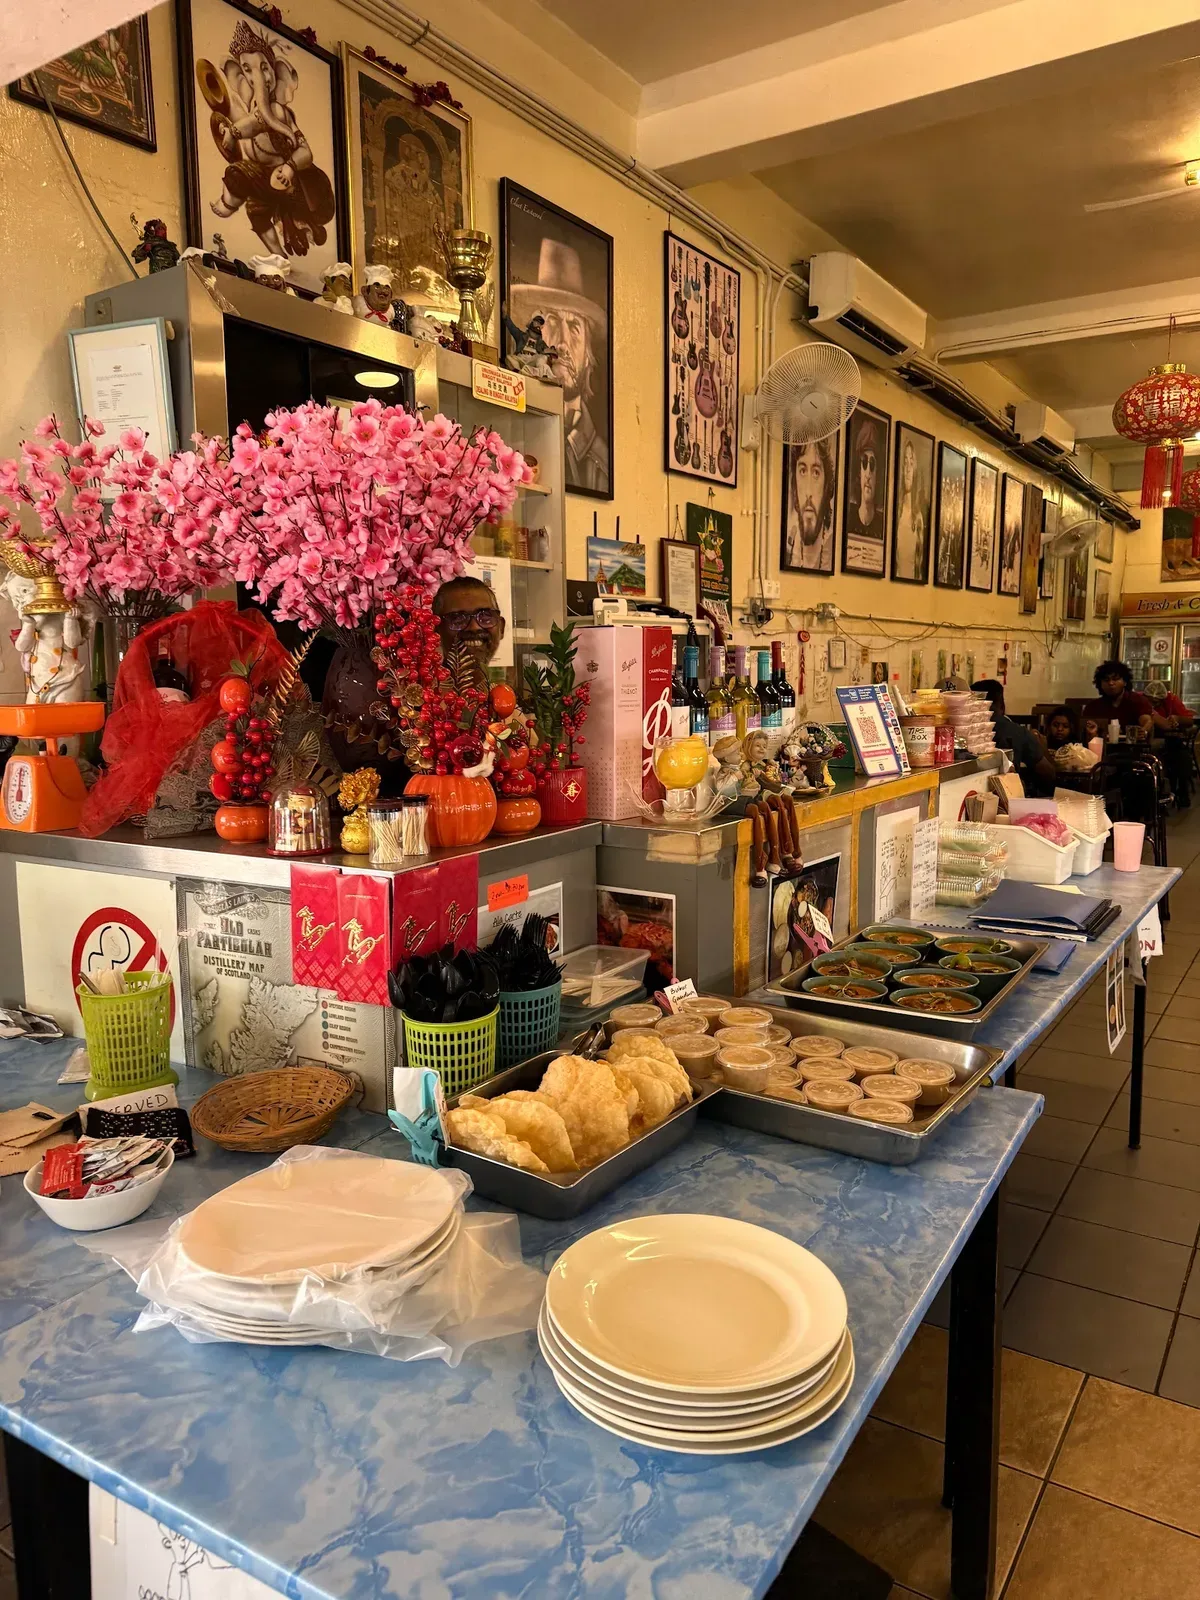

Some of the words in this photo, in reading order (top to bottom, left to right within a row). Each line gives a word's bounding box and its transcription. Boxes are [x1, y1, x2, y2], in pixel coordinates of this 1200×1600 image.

[1137, 598, 1170, 611] Fresh
[1173, 599, 1184, 610] &
[648, 667, 670, 676] CHAMPAGNE
[908, 727, 925, 735] TIPS
[247, 928, 261, 936] CASKS
[196, 930, 273, 958] PARTICULAR
[203, 954, 246, 970] DISTILLERY
[248, 962, 265, 973] MAP
[216, 967, 223, 975] OF
[224, 968, 251, 980] SCOTLAND
